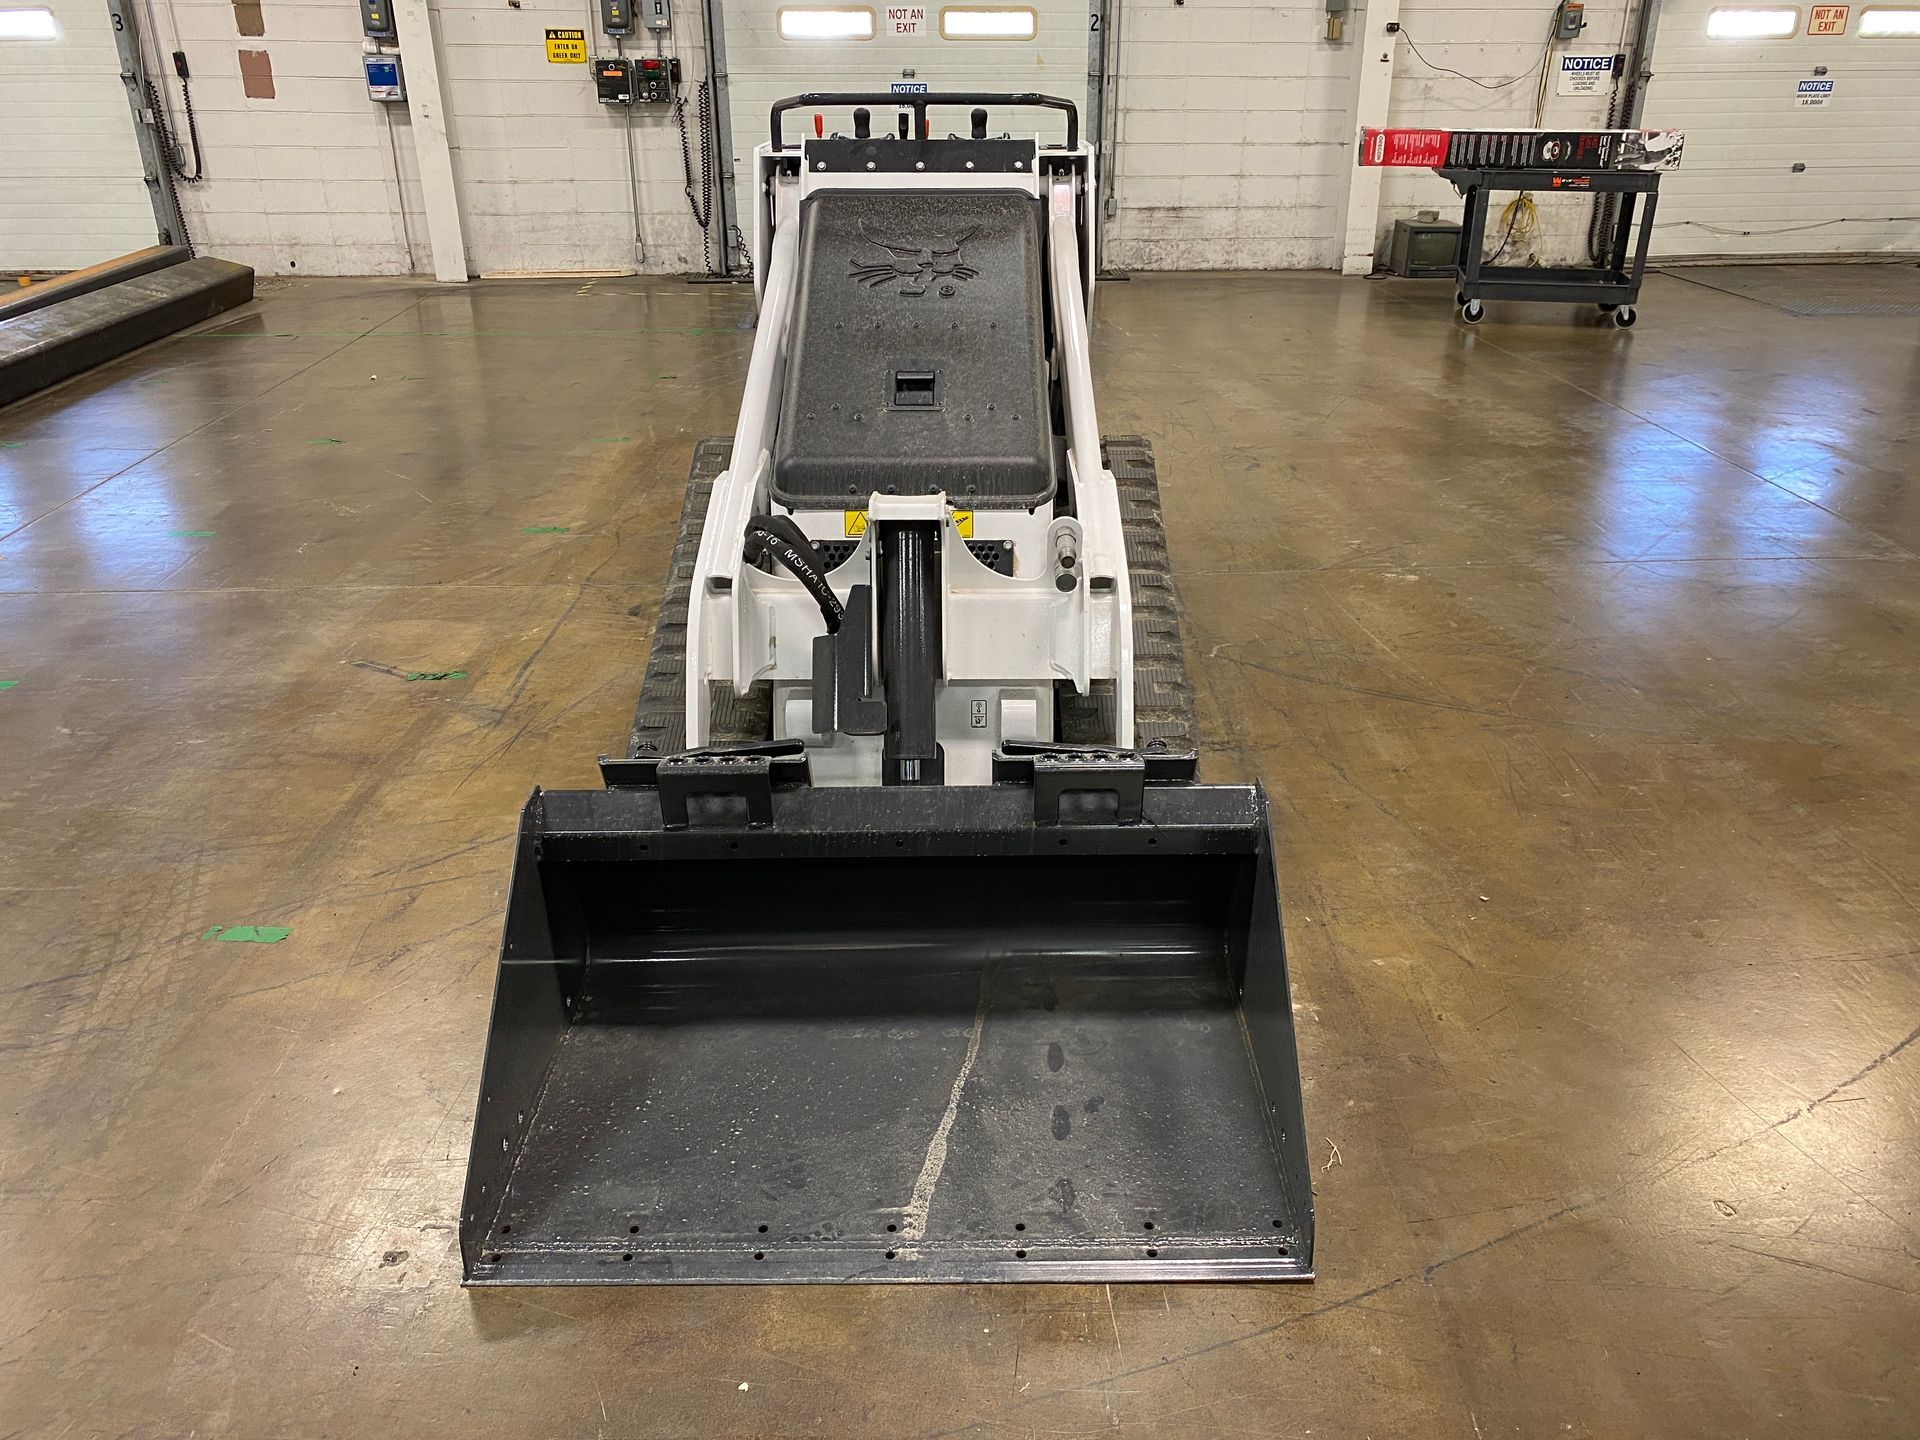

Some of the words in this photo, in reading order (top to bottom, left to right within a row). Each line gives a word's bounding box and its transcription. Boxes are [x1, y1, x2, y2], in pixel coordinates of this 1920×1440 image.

[888, 9, 908, 20] NOT
[910, 9, 924, 20] AN
[1814, 9, 1831, 20] NOT
[1833, 9, 1845, 20] AN
[112, 13, 124, 31] 3
[896, 22, 917, 33] EXIT
[1090, 14, 1100, 31] 2
[1817, 21, 1837, 32] EXIT
[557, 31, 582, 39] CAUTION
[1564, 58, 1610, 70] NOTICE
[892, 84, 926, 94] NOTICE
[1799, 82, 1833, 91] NOTICE
[1376, 135, 1385, 162] OREGON
[783, 548, 819, 584] MSHA
